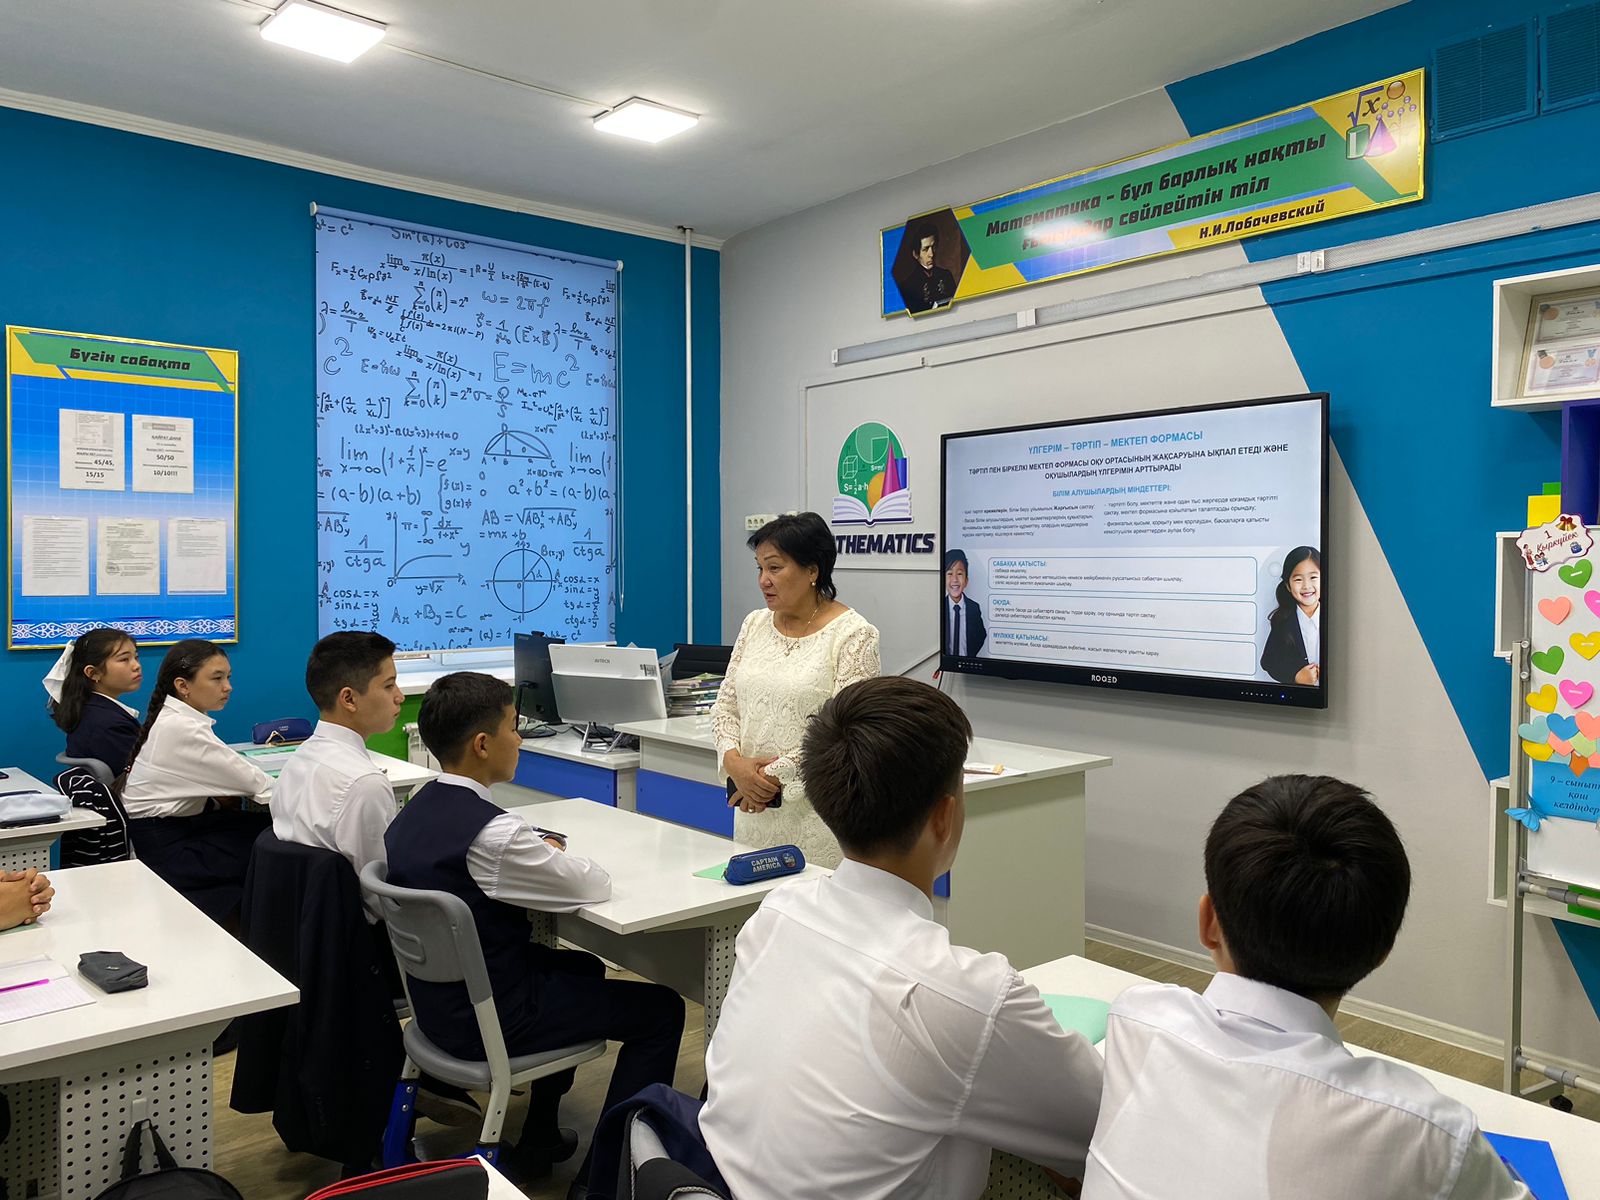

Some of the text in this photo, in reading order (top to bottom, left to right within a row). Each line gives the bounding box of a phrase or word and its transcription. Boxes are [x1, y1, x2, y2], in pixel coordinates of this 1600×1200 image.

[985, 195, 1101, 237] Математика
[1120, 180, 1153, 202] бұл
[1159, 156, 1239, 190] барлық
[1244, 134, 1327, 169] нақты
[1119, 188, 1223, 226] сөйлейтін
[1230, 175, 1270, 199] тіл
[1199, 200, 1325, 239] Н.И.Лобачевский
[69, 348, 191, 371] Бүгін сабақта
[1028, 444, 1062, 454] ҮЛГЕРІМ
[1071, 440, 1101, 451] ТӘРТІП
[1110, 436, 1147, 447] МЕКТЕП
[1150, 431, 1203, 444] ФОРМАСЫ
[1029, 462, 1054, 471] МЕКТЕП
[1054, 459, 1089, 469] ФОРМАСЫ
[1105, 455, 1151, 465] ОРТАСЫНЫҢ
[1152, 450, 1206, 462] ЖАҚСАРУЫНА
[1207, 447, 1237, 458] ЫҚПАЛ
[1238, 445, 1262, 455] ЕТЕДІ
[1263, 443, 1289, 453] ЖӘНЕ
[1045, 463, 1182, 480] ОҚУШЫЛАРДЫҢ ҮЛГЕРІМІН АРТТЫРАДЫ
[1071, 486, 1126, 497] АЛУШЫЛАРДЫҢ
[835, 533, 935, 554] THEMATICS
[1544, 530, 1552, 539] 1
[1550, 776, 1556, 784] 9
[1565, 779, 1600, 790] сынып
[751, 856, 779, 867] CAPTAIN
[752, 862, 782, 873] AMERICA
